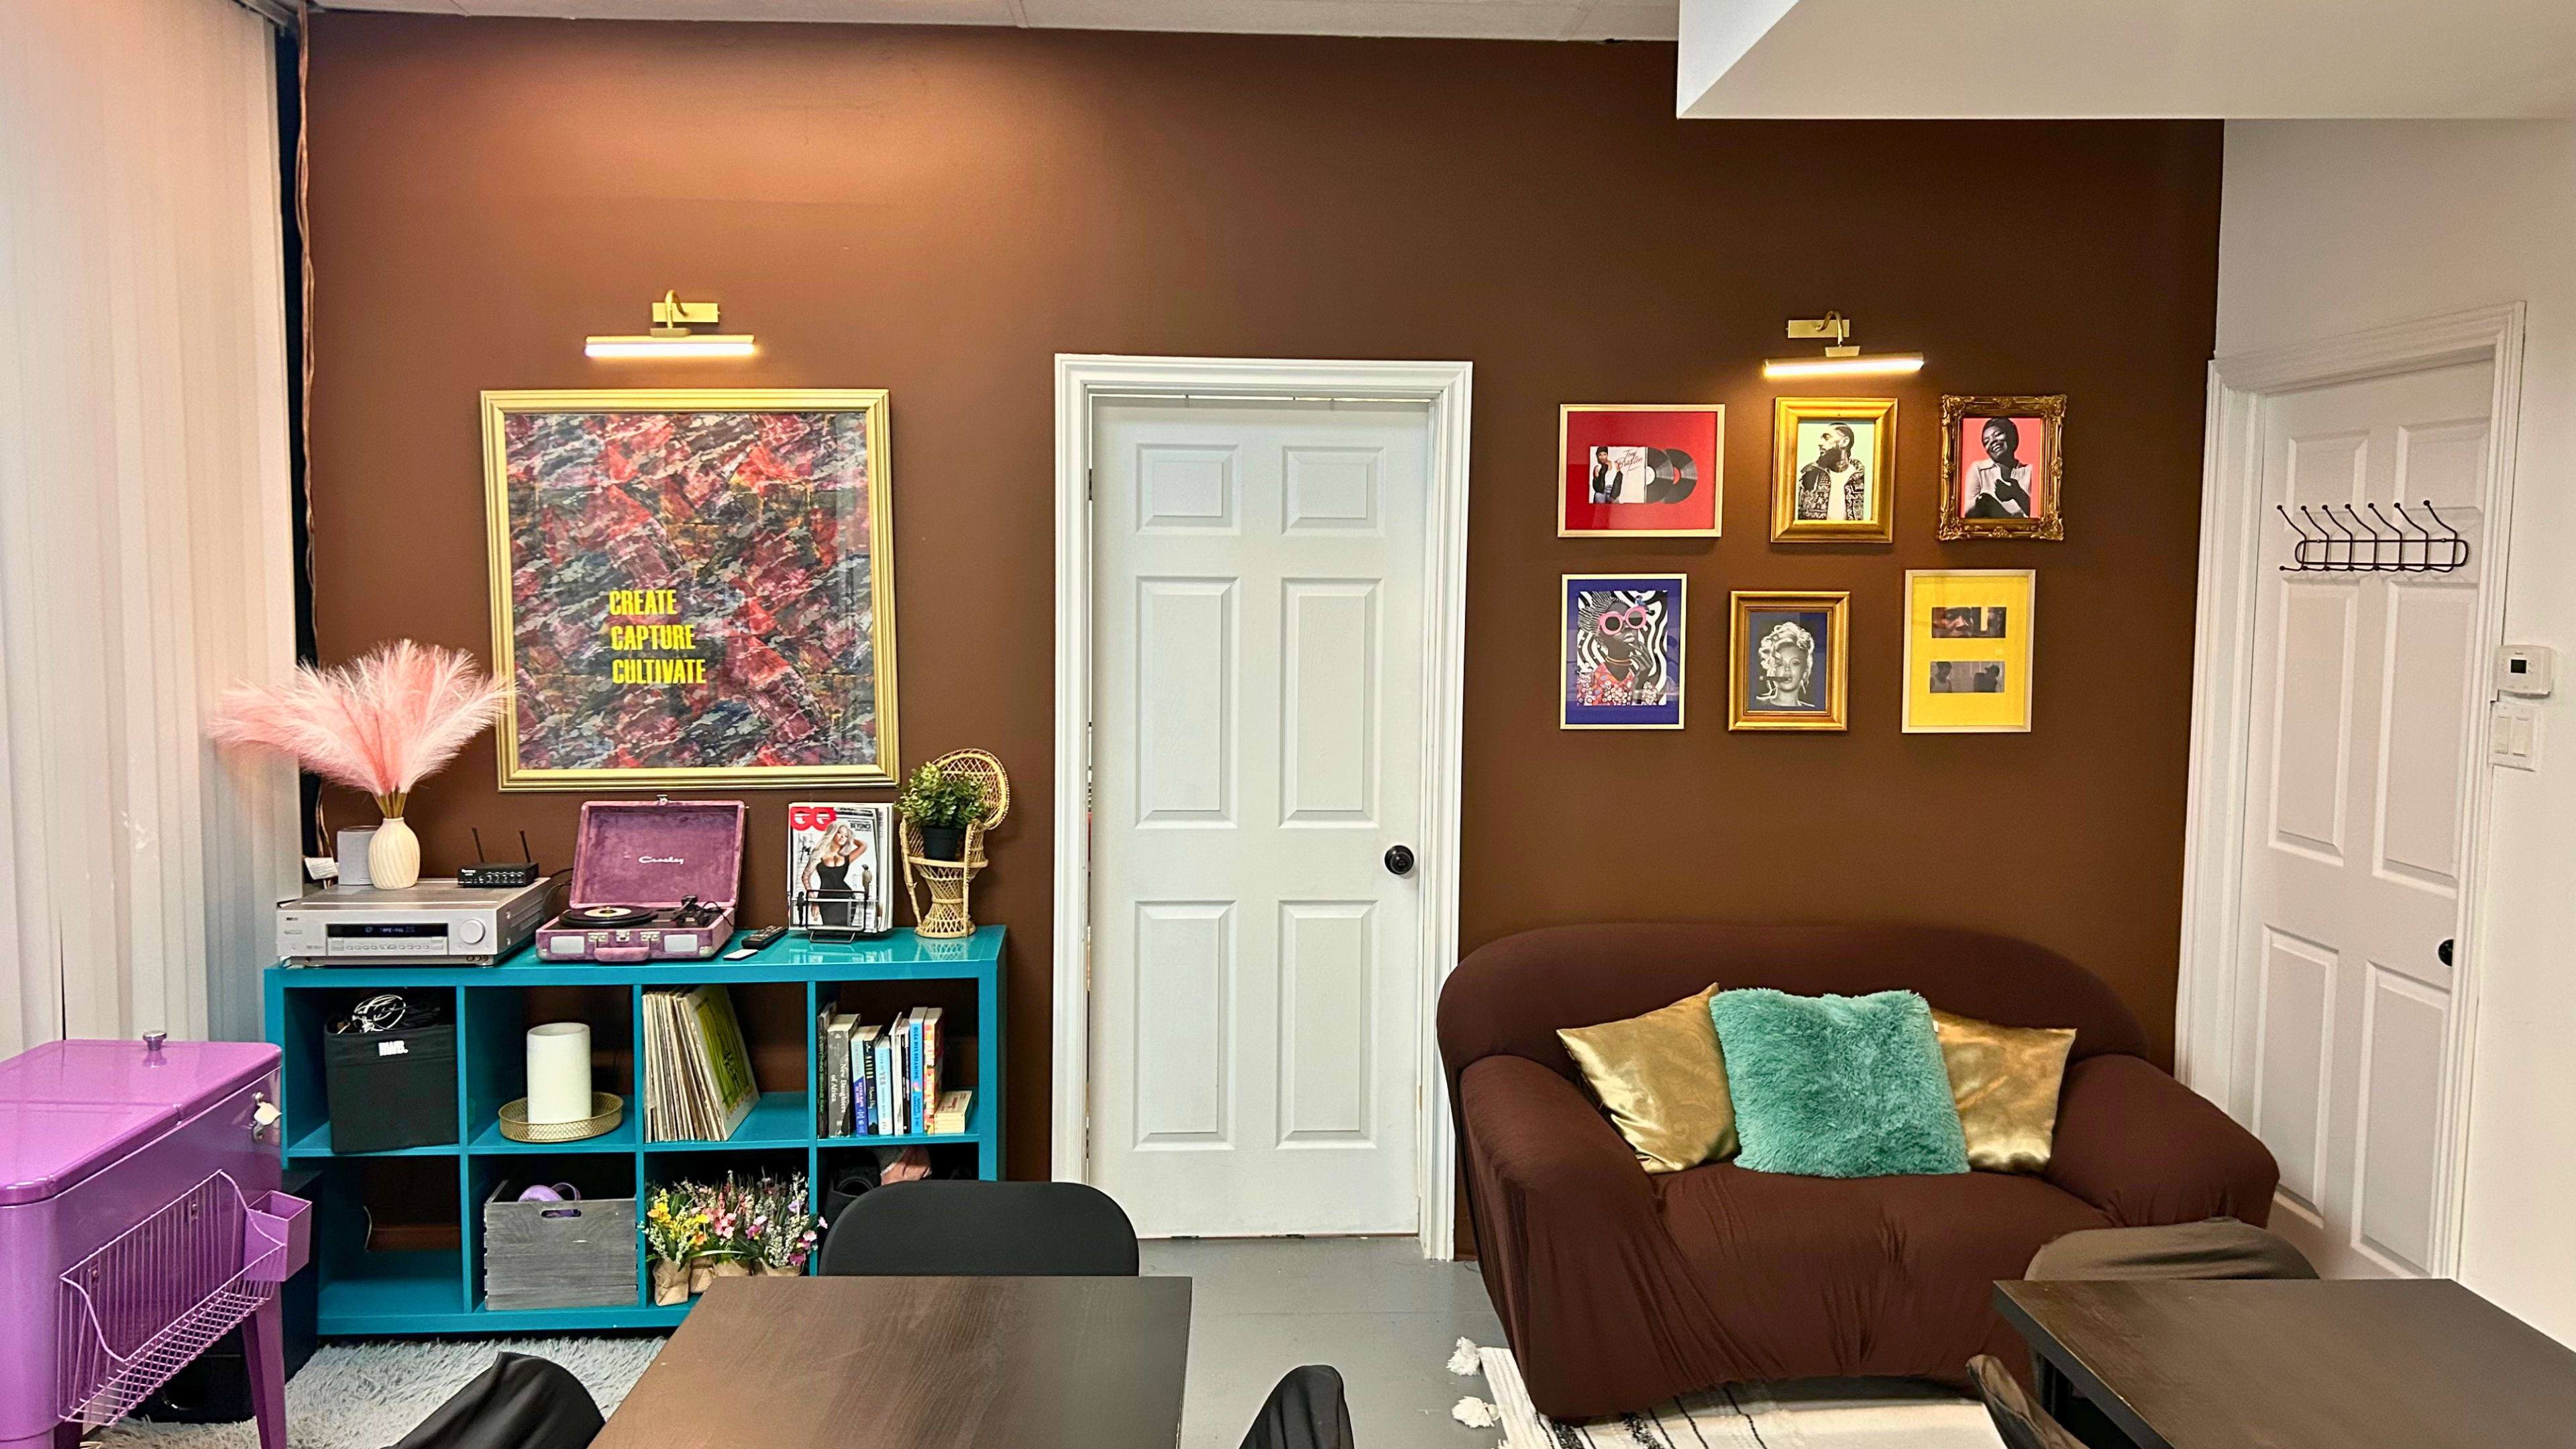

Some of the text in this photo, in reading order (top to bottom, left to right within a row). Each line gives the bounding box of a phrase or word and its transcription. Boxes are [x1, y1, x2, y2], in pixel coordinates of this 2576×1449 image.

[609, 589, 678, 616] CREATE
[610, 624, 696, 651] CAPTURE
[612, 658, 706, 684] CULTIVATE
[790, 807, 837, 831] GQ
[638, 855, 684, 865] Crosley
[831, 1074, 838, 1083] of
[839, 1079, 847, 1113] Daughters
